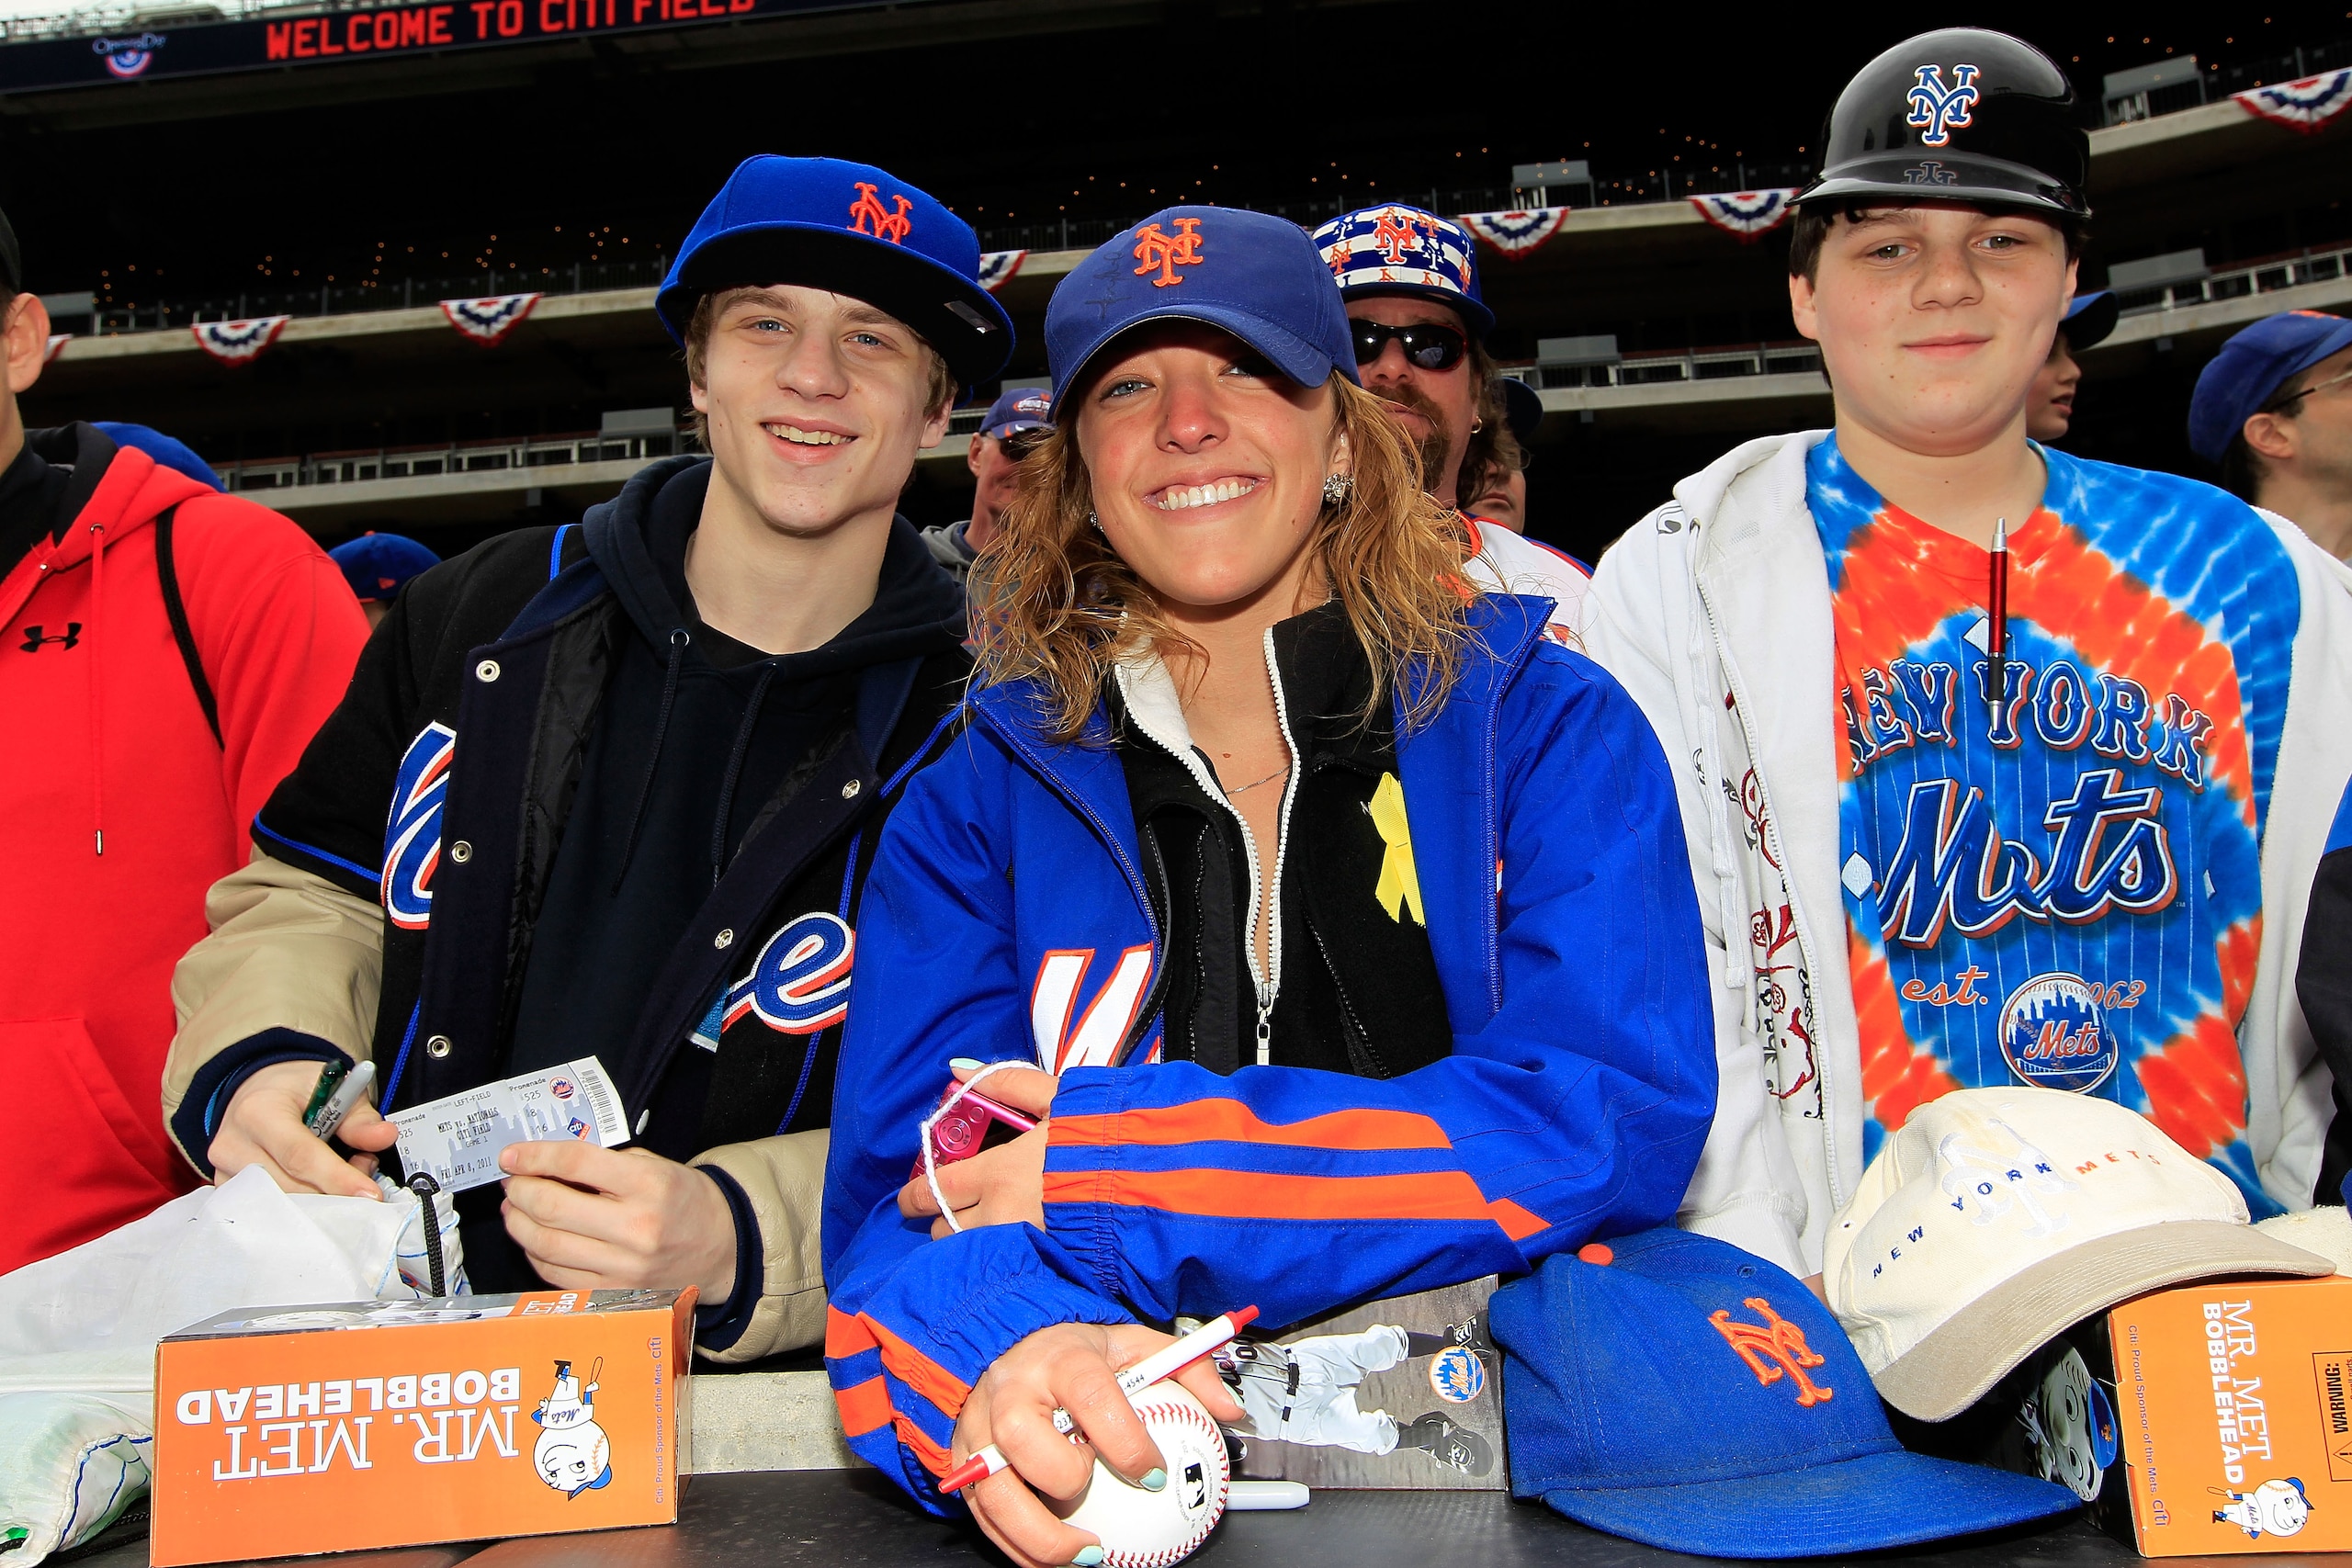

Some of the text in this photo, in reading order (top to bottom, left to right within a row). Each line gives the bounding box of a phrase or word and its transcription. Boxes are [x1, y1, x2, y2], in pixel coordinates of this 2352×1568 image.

[266, 6, 454, 61] WELCOME
[469, 0, 524, 39] TO
[539, 0, 616, 32] CITI
[1972, 659, 2215, 794] YORK
[1901, 964, 1989, 1006] est.
[2088, 979, 2147, 1010] 962
[2024, 1019, 2100, 1059] Mets
[509, 1077, 547, 1091] Promenade
[524, 1090, 541, 1101] 525
[454, 1090, 492, 1107] LEFT-FIELD
[393, 1113, 426, 1126] Promenade
[399, 1128, 413, 1139] 525
[437, 1121, 453, 1134] METS
[467, 1107, 499, 1124] NATIONALS
[457, 1122, 492, 1141] CITI FIELD
[466, 1137, 481, 1148] GAME
[411, 1161, 420, 1171] 16
[441, 1168, 452, 1179] FRI
[455, 1164, 466, 1176] APR
[478, 1156, 492, 1169] 2011
[1872, 1149, 2162, 1279] NEW YORK METS
[2128, 1325, 2138, 1347] Citi:
[654, 1361, 662, 1385] Mets.
[1450, 1355, 1469, 1394] Mets
[2132, 1349, 2143, 1382] Proud
[2202, 1302, 2245, 1484] BOBBLEHEAD
[2222, 1299, 2272, 1461] MR. MET
[176, 1367, 520, 1426] BOBBLEHEAD
[655, 1404, 662, 1413] of
[2136, 1384, 2149, 1430] Sponsor
[2325, 1362, 2349, 1434] WARNING:
[551, 1408, 580, 1425] Mets
[213, 1404, 520, 1482] MR. MET
[655, 1415, 664, 1453] Sponsor
[2143, 1433, 2153, 1444] of
[655, 1455, 663, 1483] Proud
[2144, 1446, 2154, 1464] the
[2148, 1466, 2157, 1496] Mets.
